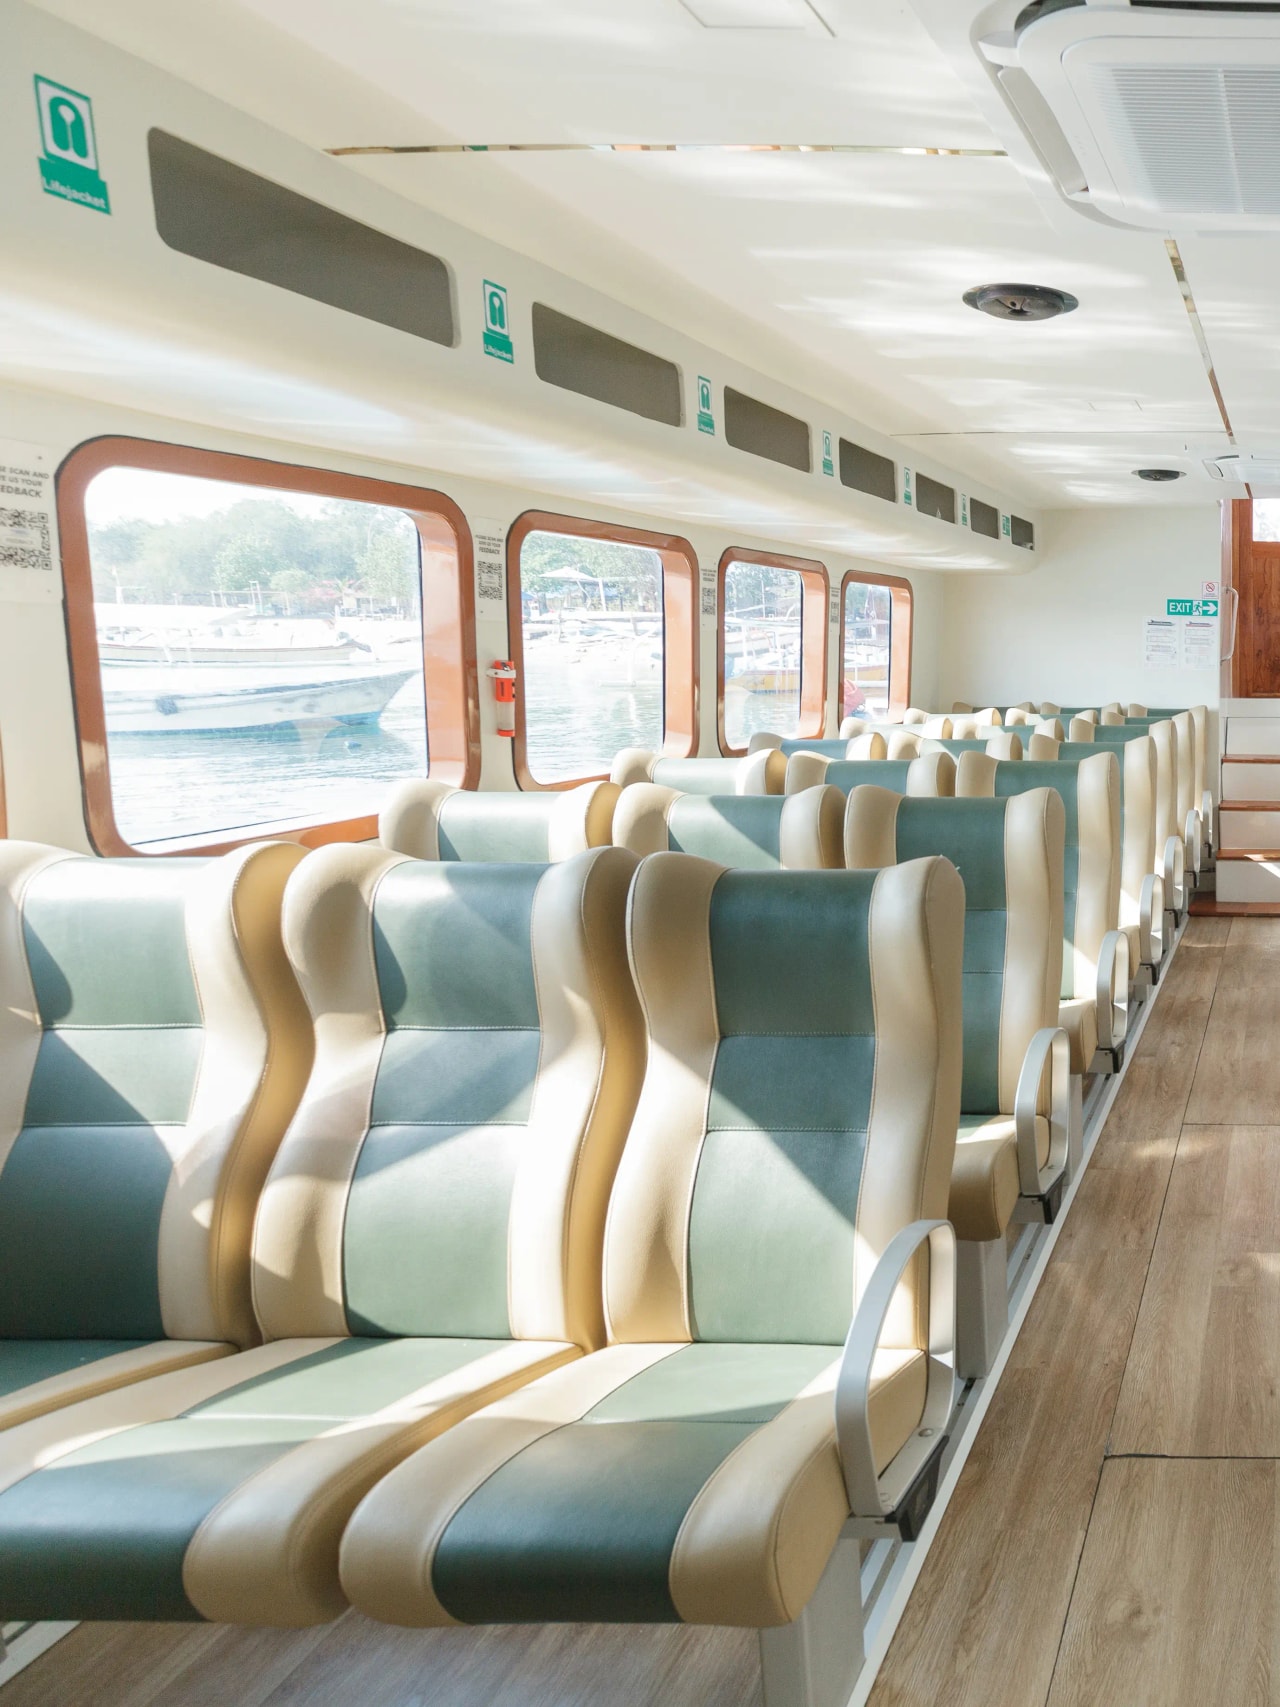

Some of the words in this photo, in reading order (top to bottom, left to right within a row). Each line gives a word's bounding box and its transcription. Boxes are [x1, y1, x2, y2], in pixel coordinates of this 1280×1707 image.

[43, 176, 107, 209] Lifejacket
[485, 343, 513, 361] Lifejacket
[9, 467, 30, 476] SCAN
[32, 471, 49, 480] AND
[21, 478, 42, 487] YOUR
[1169, 602, 1192, 613] EXIT
